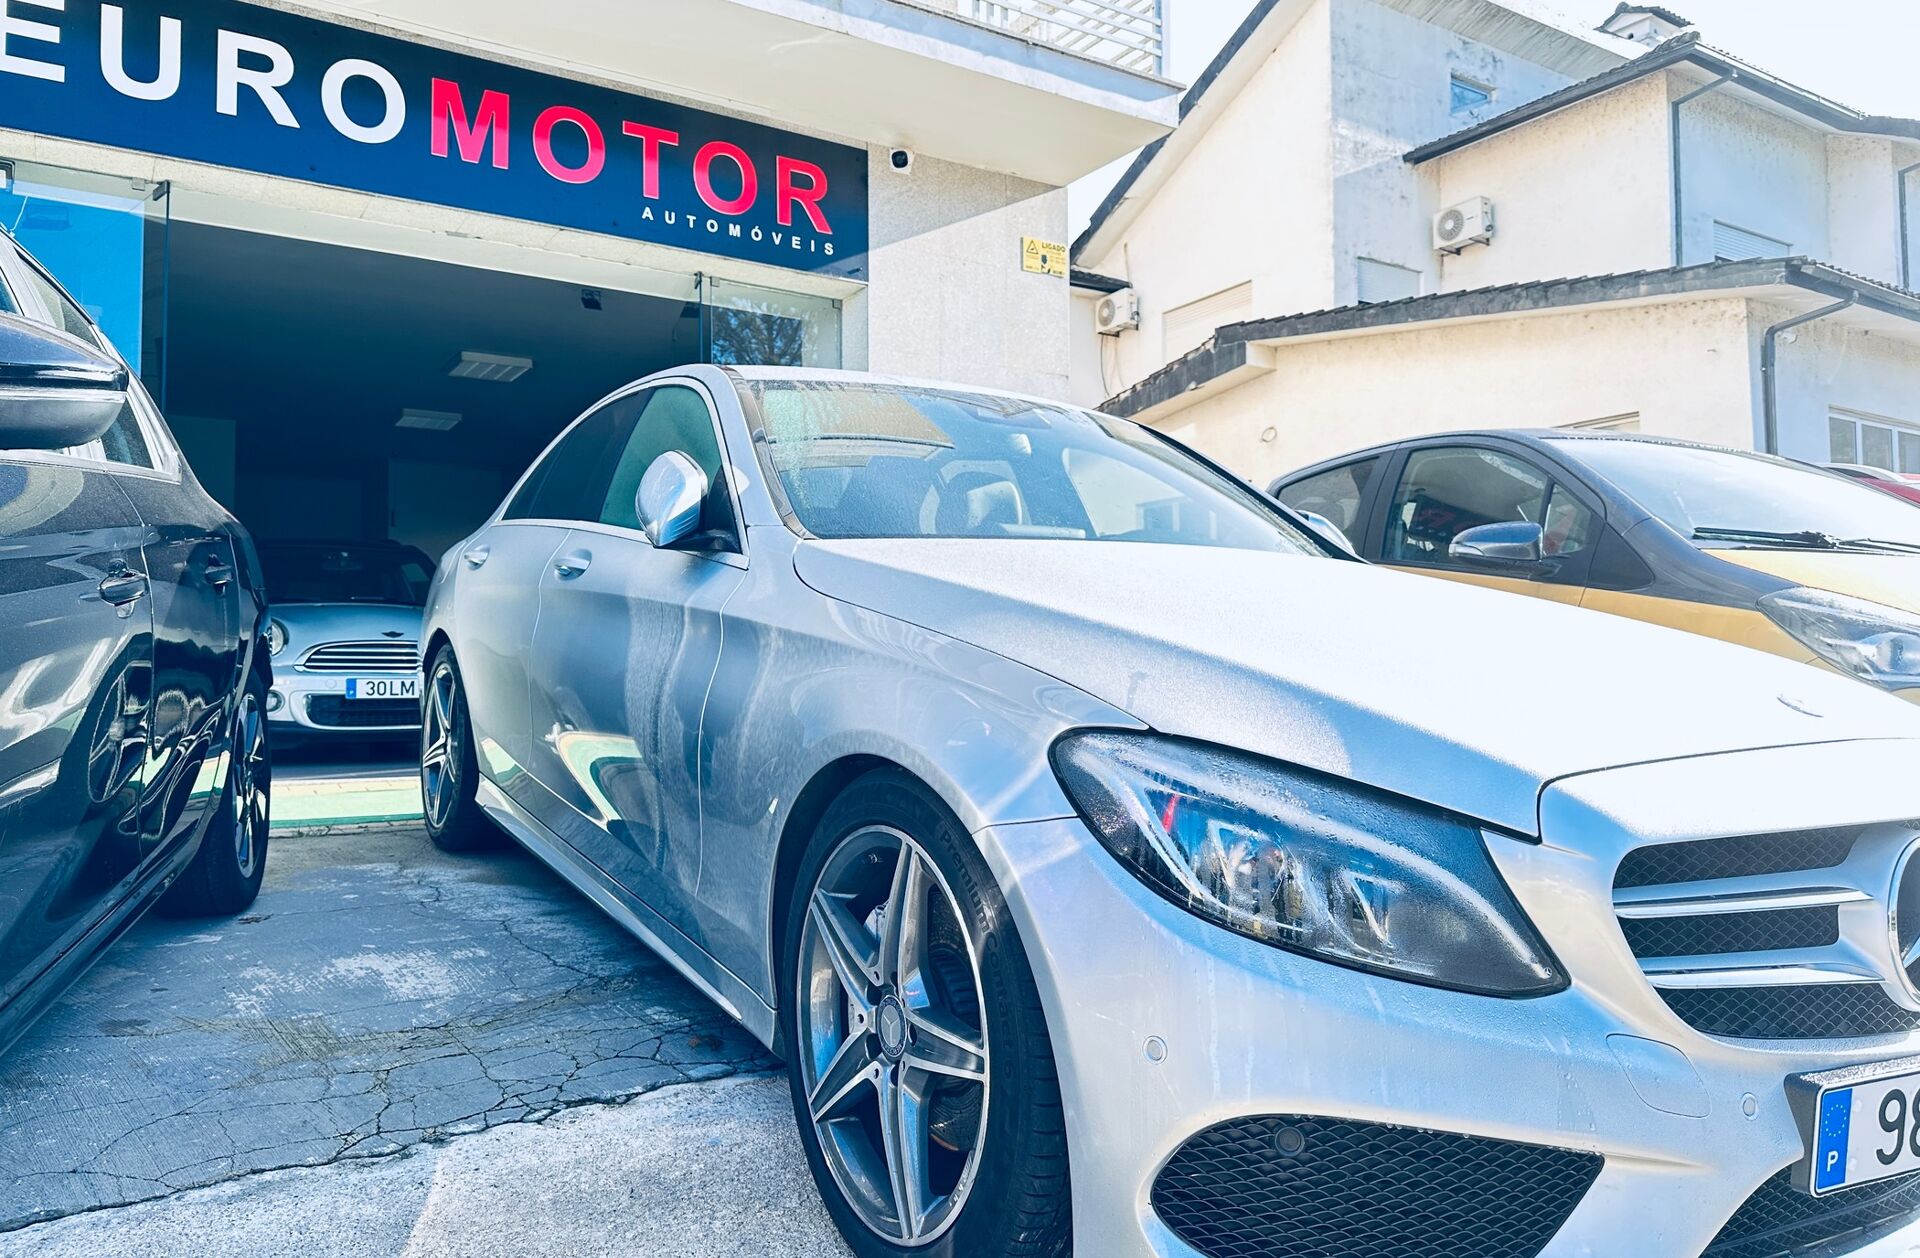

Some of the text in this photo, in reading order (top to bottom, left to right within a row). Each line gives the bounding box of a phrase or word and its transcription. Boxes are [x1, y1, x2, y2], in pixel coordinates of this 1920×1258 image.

[0, 0, 833, 235] EUROMOTOR
[641, 206, 834, 256] AUTOMÓVEIS
[1041, 241, 1066, 253] LIGADO
[1826, 1150, 1839, 1172] P
